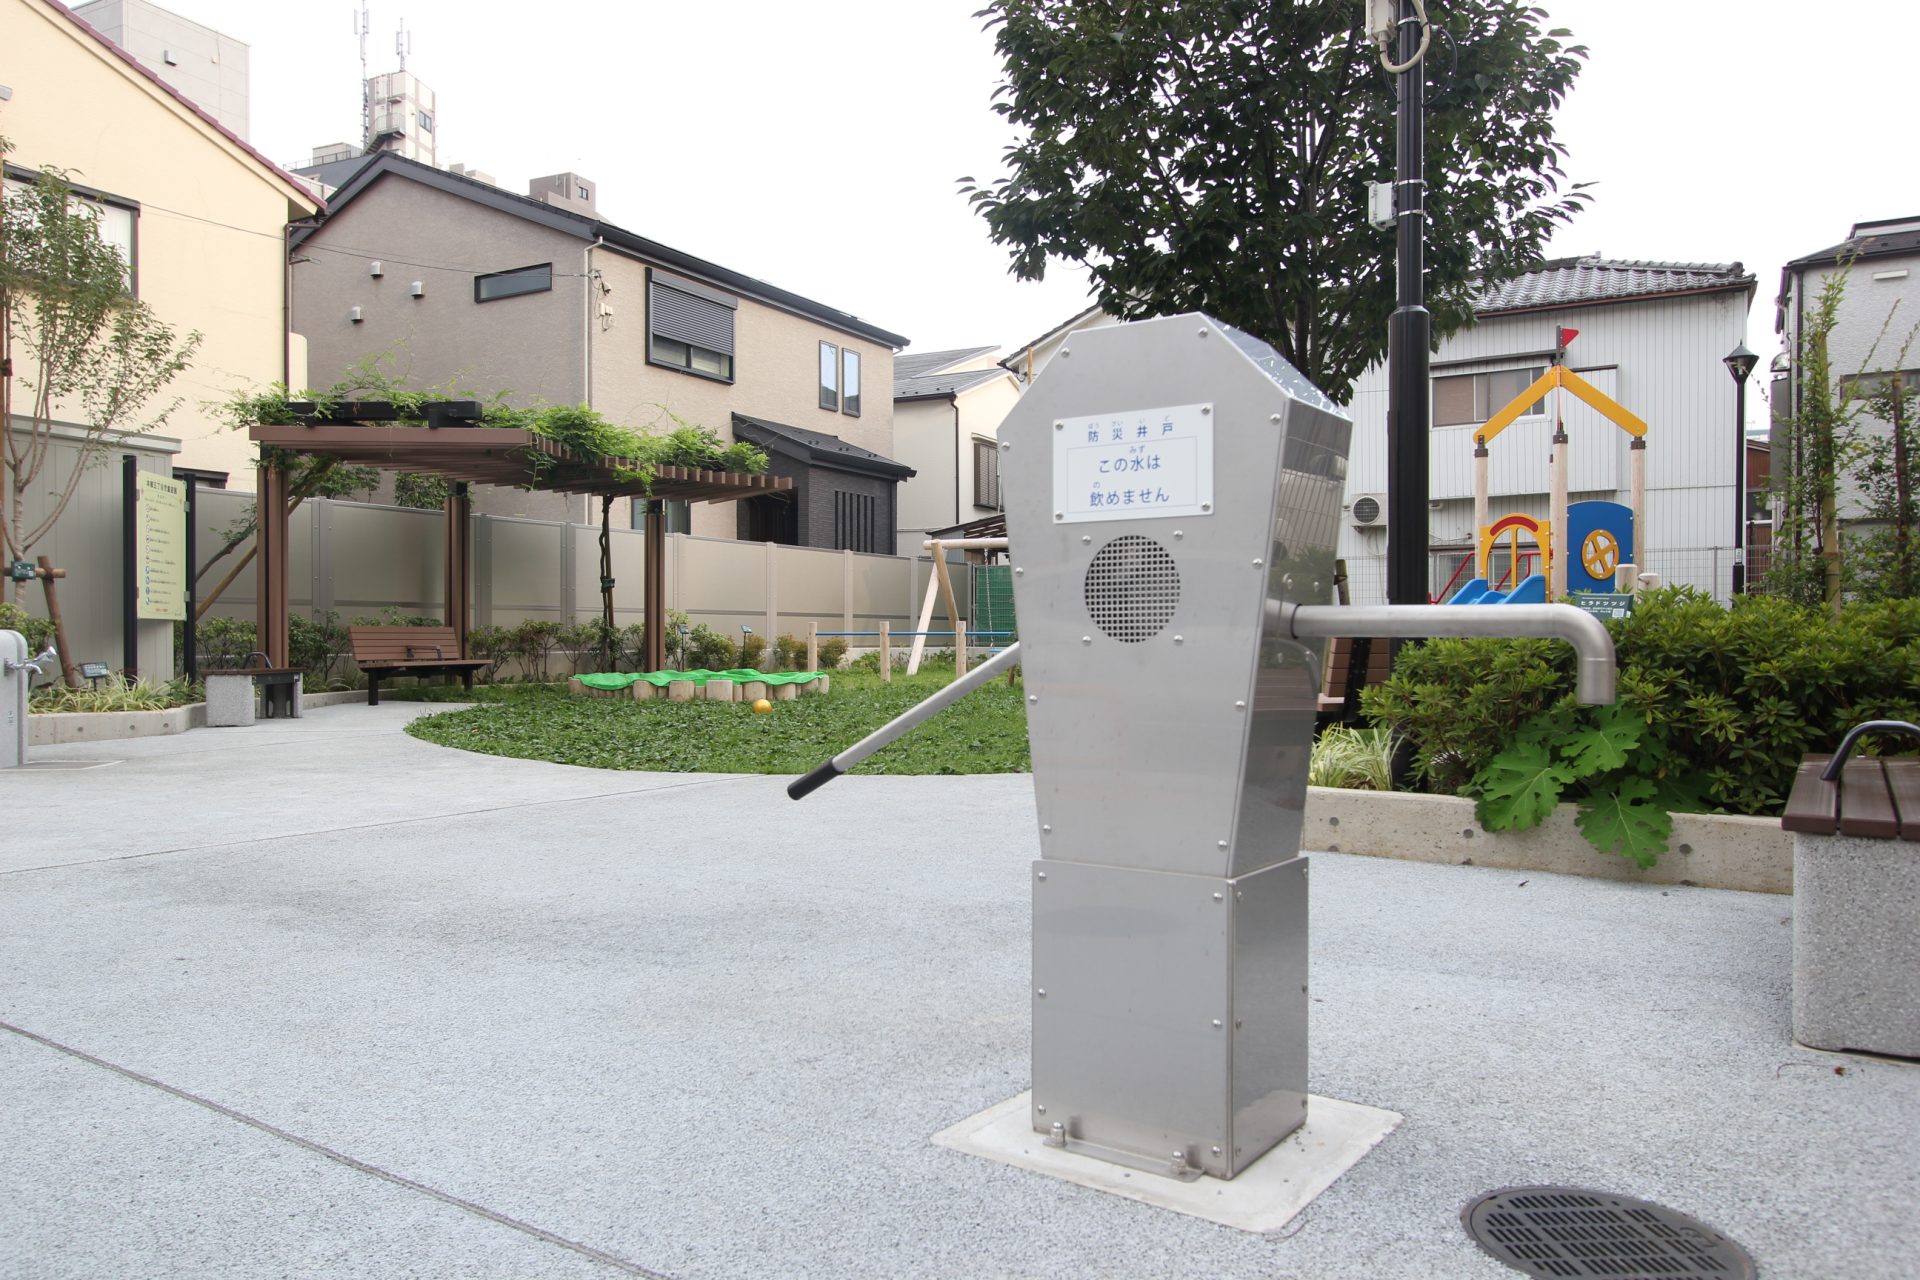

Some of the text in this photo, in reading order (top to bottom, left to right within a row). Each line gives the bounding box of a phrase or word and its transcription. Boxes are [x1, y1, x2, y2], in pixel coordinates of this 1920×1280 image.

[1088, 422, 1174, 443] 防災井戸
[1129, 445, 1146, 454] みず
[1099, 454, 1161, 473] この水は
[1093, 481, 1101, 489] の
[1090, 487, 1170, 507] 飲めません
